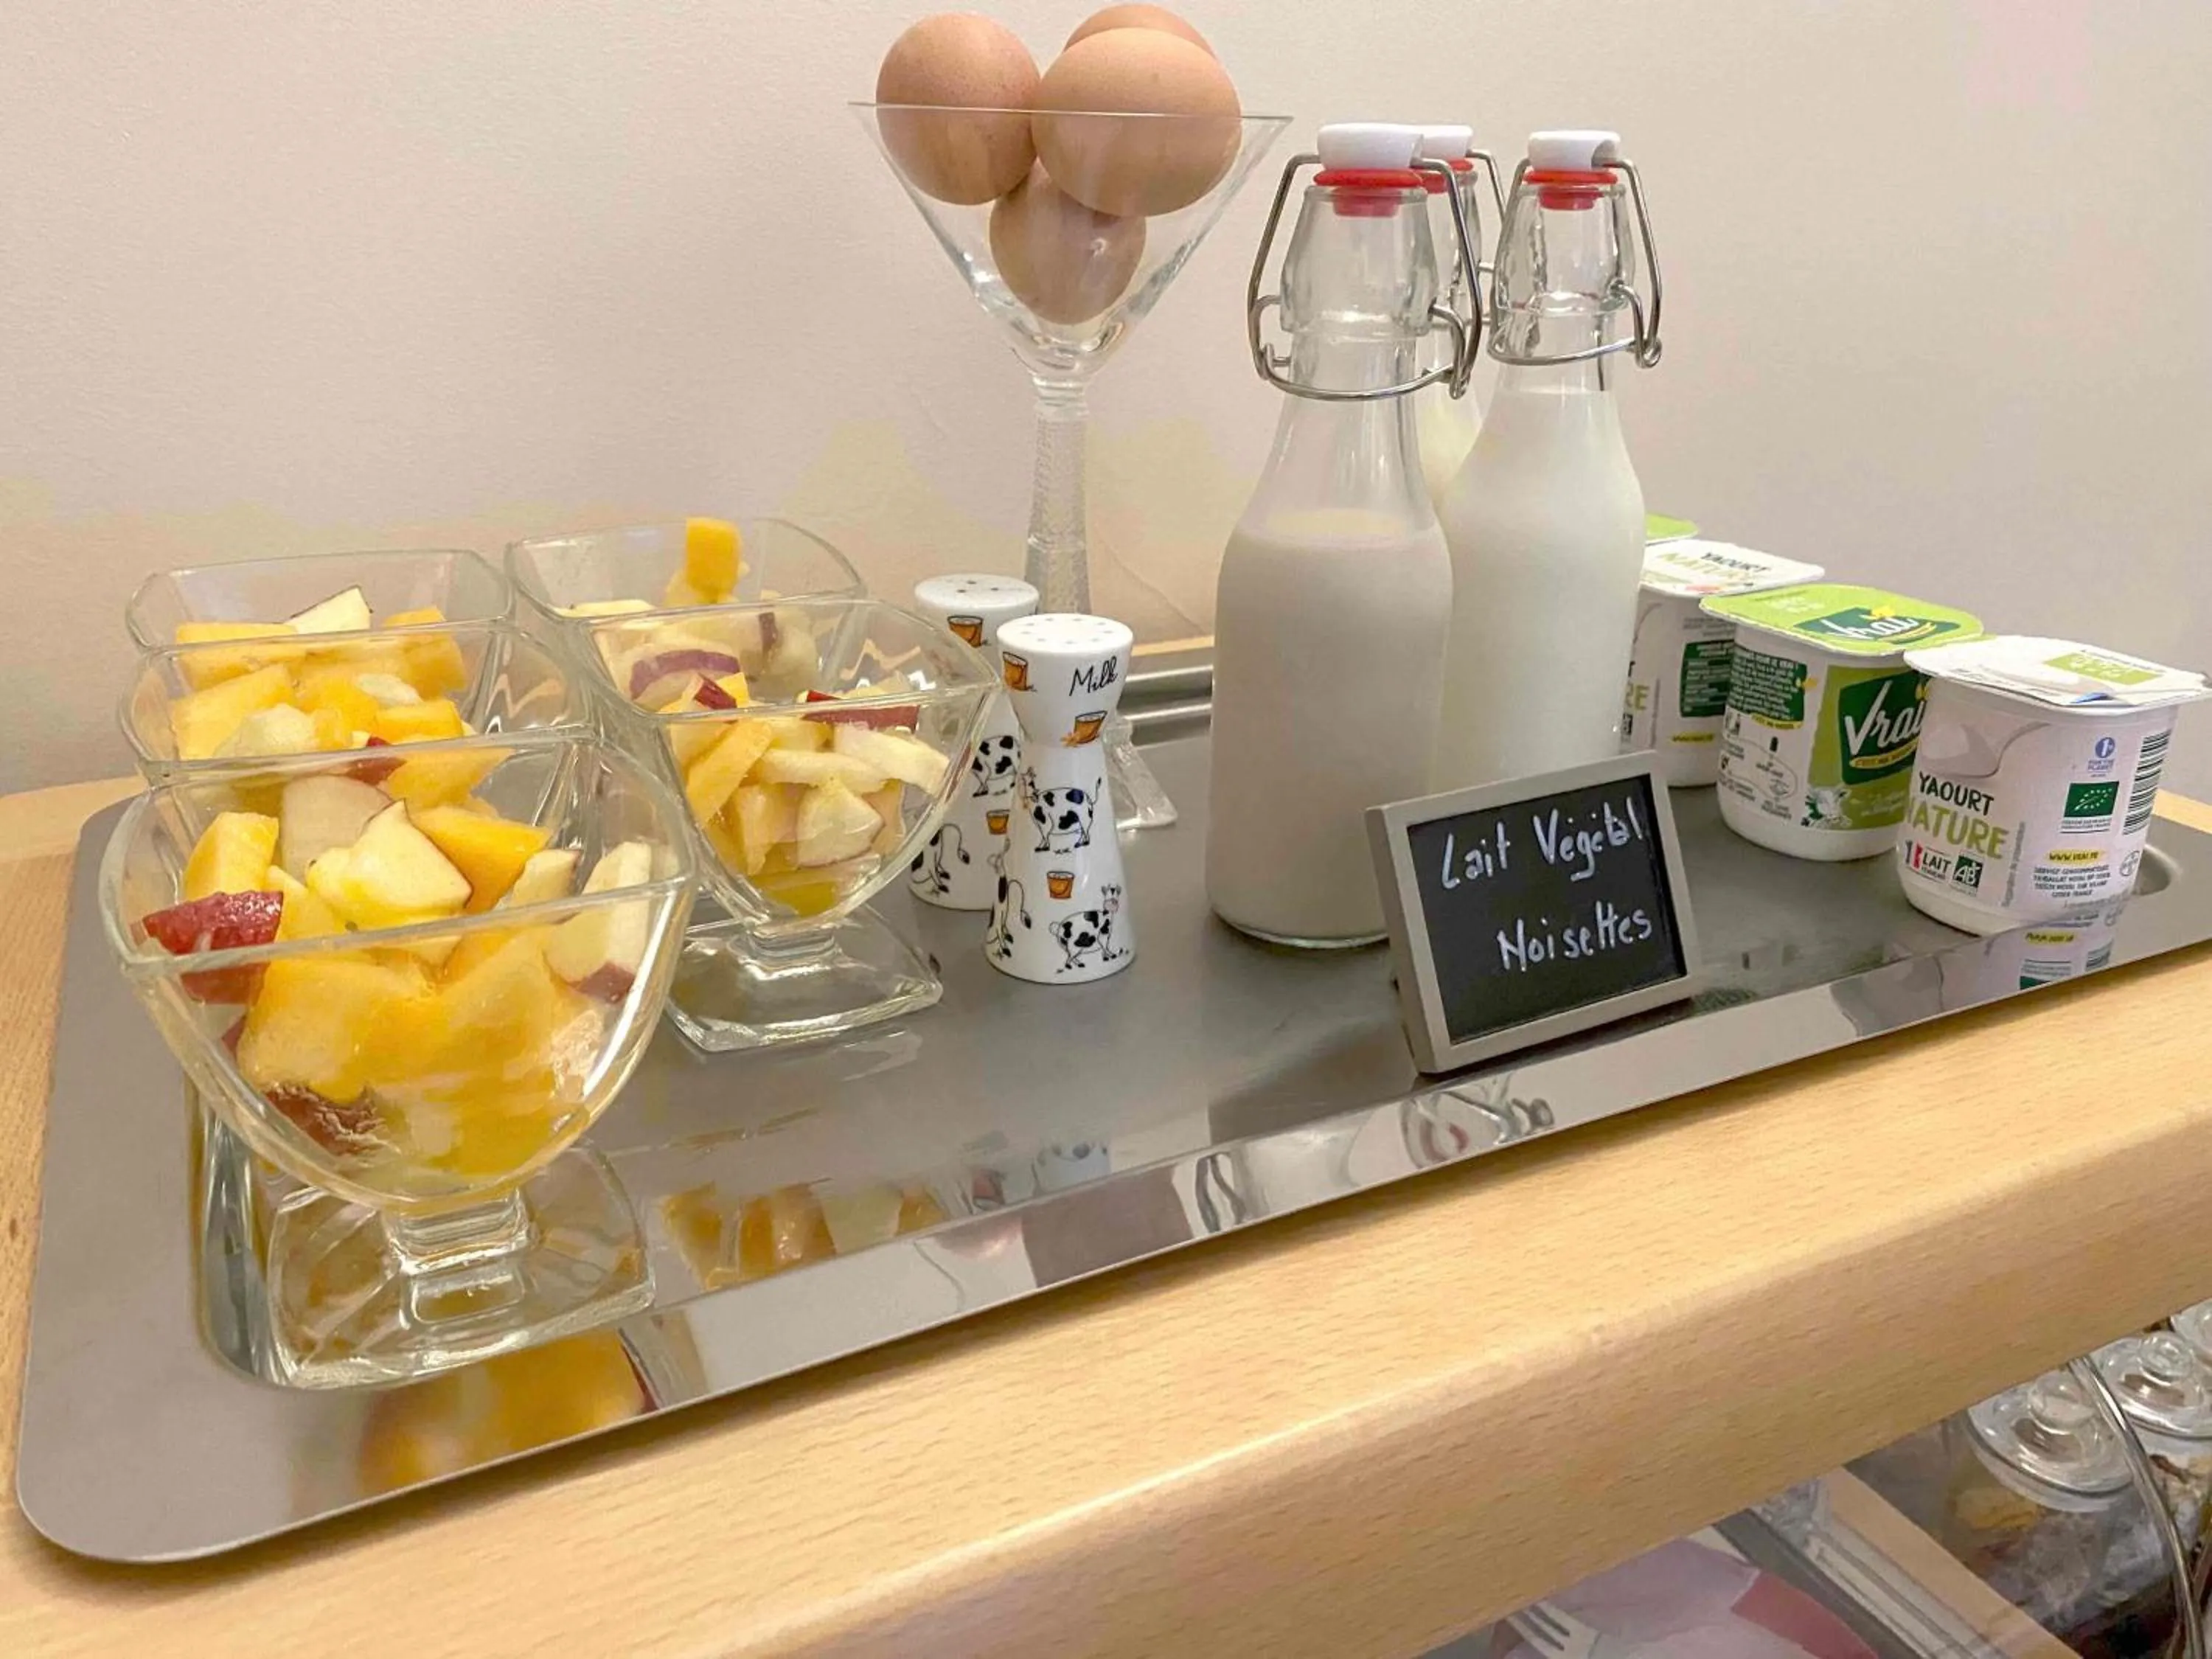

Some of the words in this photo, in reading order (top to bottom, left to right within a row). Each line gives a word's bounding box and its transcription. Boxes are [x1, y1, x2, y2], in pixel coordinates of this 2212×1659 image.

[1069, 655, 1118, 697] Milk
[1919, 771, 1994, 816] YAOURT
[1441, 821, 1512, 888] Lait
[1922, 852, 1952, 874] LAIT
[1497, 900, 1653, 972] Noisettes
